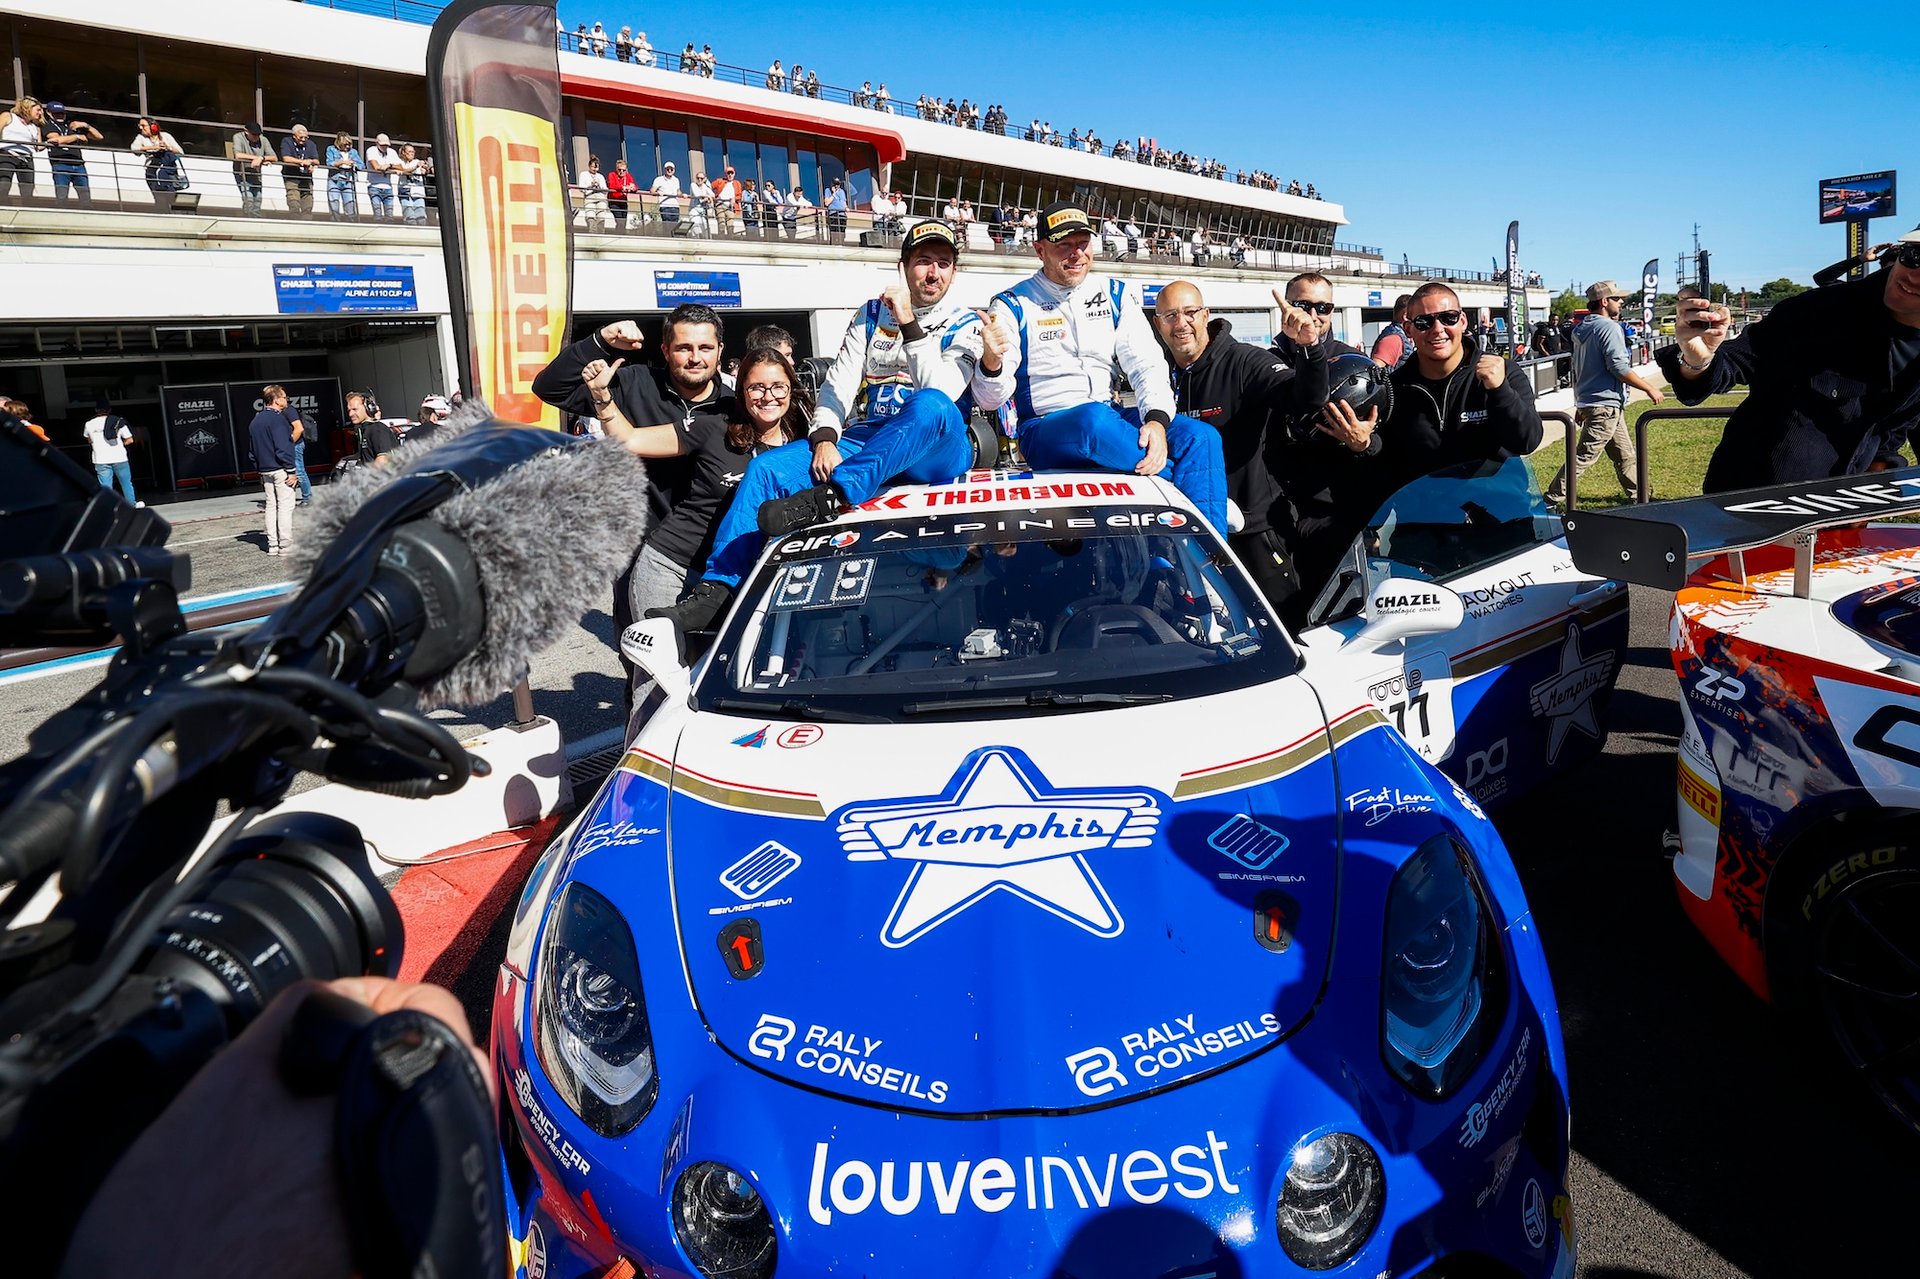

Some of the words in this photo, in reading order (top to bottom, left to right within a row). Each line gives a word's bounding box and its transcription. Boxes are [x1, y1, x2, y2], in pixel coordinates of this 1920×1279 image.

[178, 400, 214, 409] CHAZEL
[253, 396, 318, 411] CZEL
[781, 535, 833, 554] elf
[872, 516, 1097, 543] ALPINE
[1106, 511, 1158, 529] elf
[1375, 594, 1440, 609] CHAZEL
[1464, 572, 1535, 610] ACKOUT
[1470, 593, 1524, 620] WATCHES
[1546, 671, 1599, 711] Memphis
[1694, 666, 1746, 701] ZP
[1690, 689, 1739, 720] EXPERTISE
[787, 729, 814, 743] E
[1345, 787, 1390, 812] Fast
[1396, 789, 1436, 806] Lane
[1364, 803, 1432, 827] Drive
[616, 822, 661, 838] Lane
[897, 812, 1106, 849] Memphis
[1802, 894, 1813, 920] P
[1813, 846, 1897, 899] ZERO
[805, 1024, 883, 1058] RALY
[1121, 1013, 1196, 1056] RALY
[1135, 1012, 1282, 1077] CONSEILS
[795, 1047, 949, 1104] CONSEILS
[1476, 1058, 1515, 1131] AGENCY
[1517, 1027, 1530, 1065] CAR
[522, 1087, 560, 1142] AGENCY
[562, 1140, 591, 1176] CAR
[530, 1116, 544, 1138] SPORT
[547, 1140, 571, 1170] PRESTIGE
